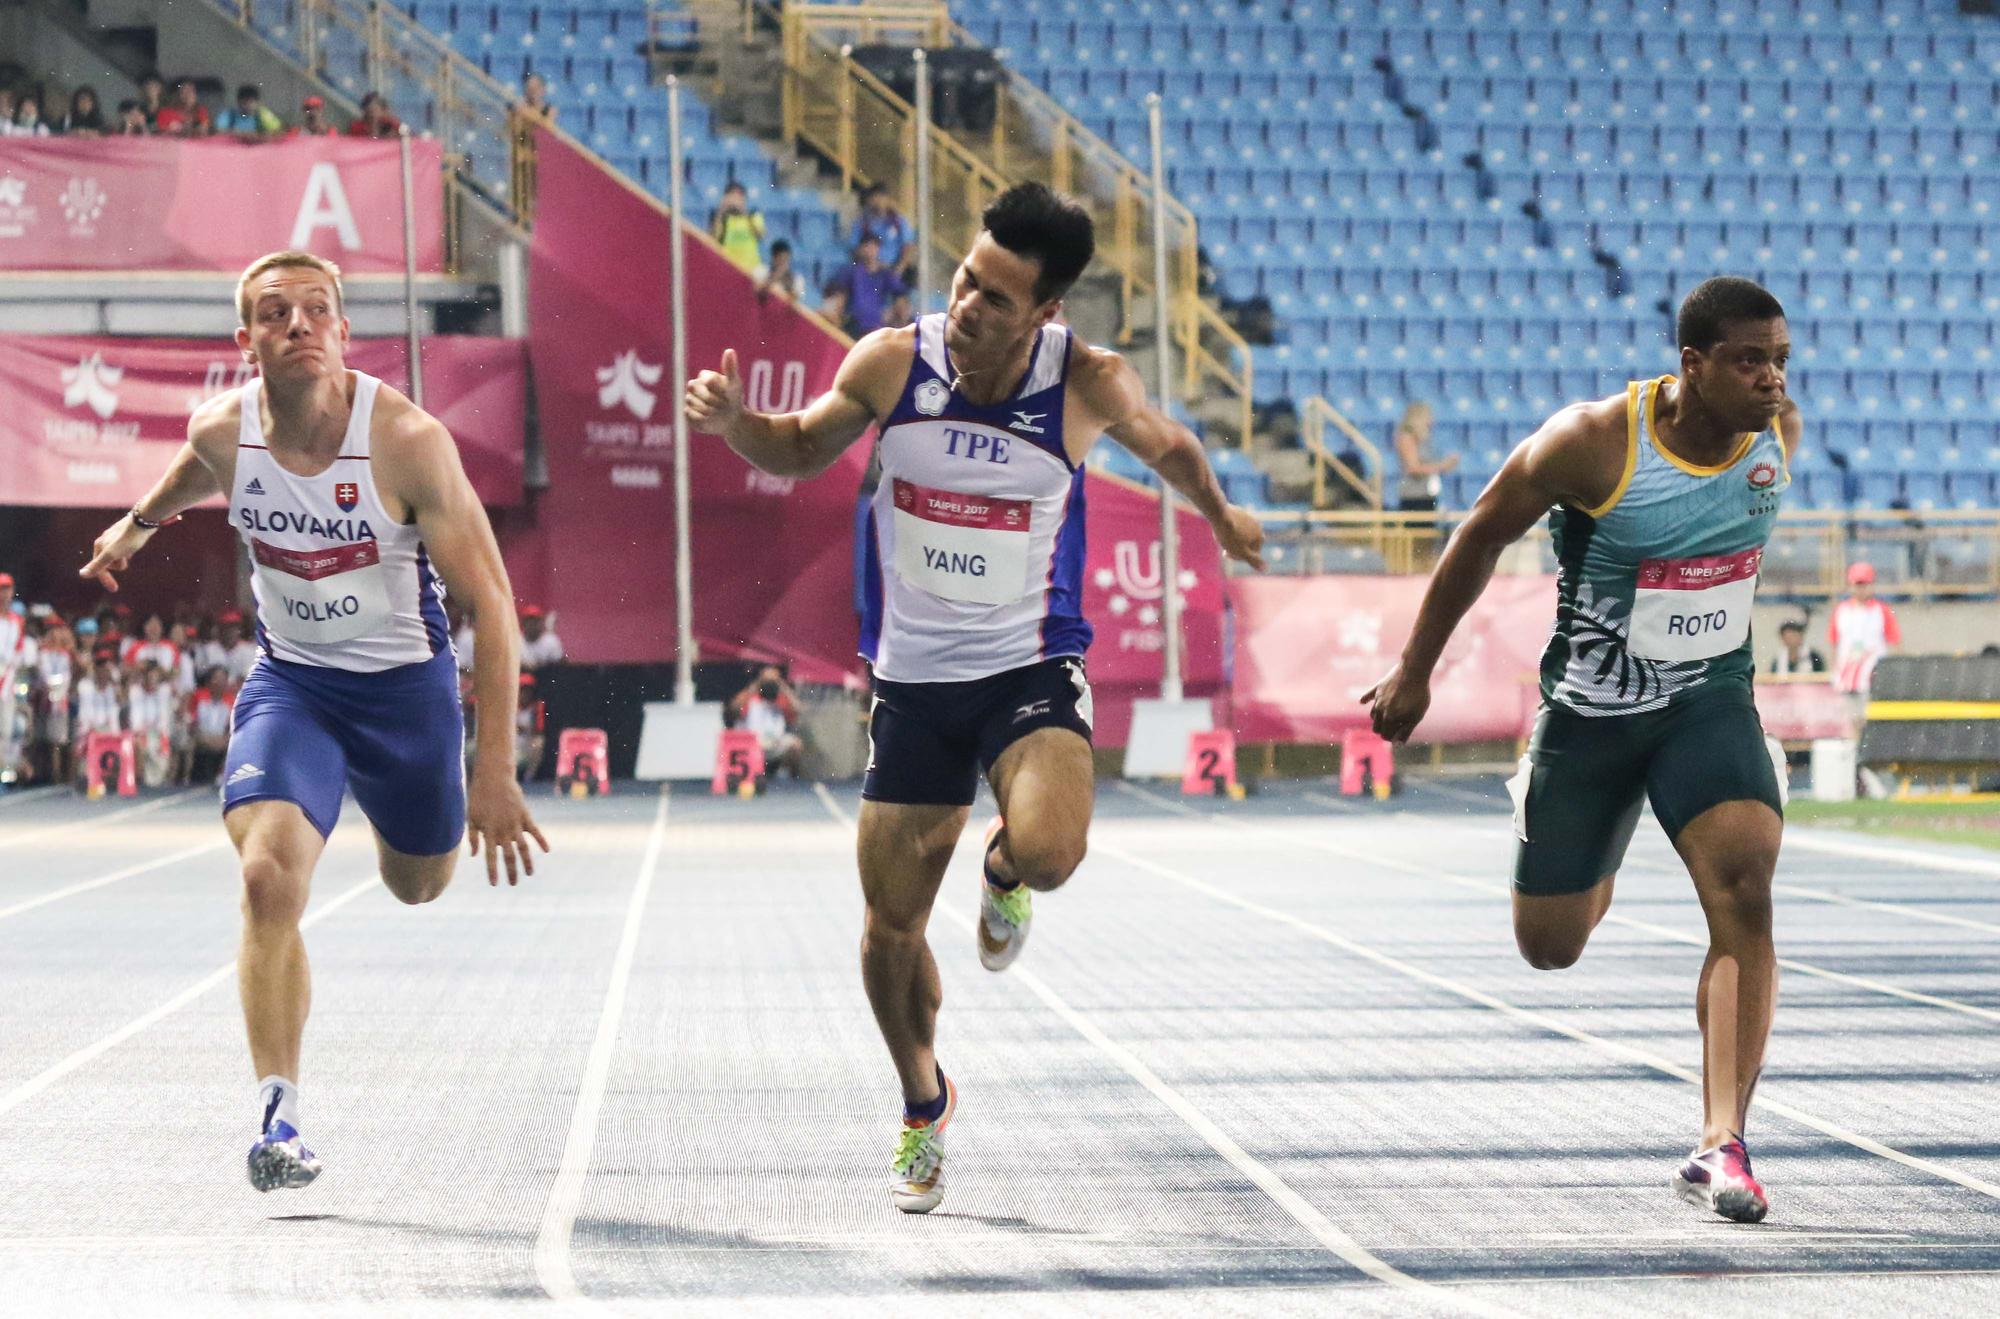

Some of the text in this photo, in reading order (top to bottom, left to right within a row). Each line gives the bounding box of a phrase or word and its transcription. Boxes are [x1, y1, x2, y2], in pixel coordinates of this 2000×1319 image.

[289, 160, 362, 250] A
[944, 428, 1010, 464] TPE
[928, 498, 990, 515] TAIPEI 2017
[240, 507, 377, 541] SLOVAKIA
[923, 545, 987, 577] YANG
[1680, 567, 1713, 577] TAIPEI
[282, 595, 359, 621] VOLKO
[1668, 609, 1727, 636] ROTO
[729, 750, 749, 780] 5
[1200, 749, 1219, 780] 2
